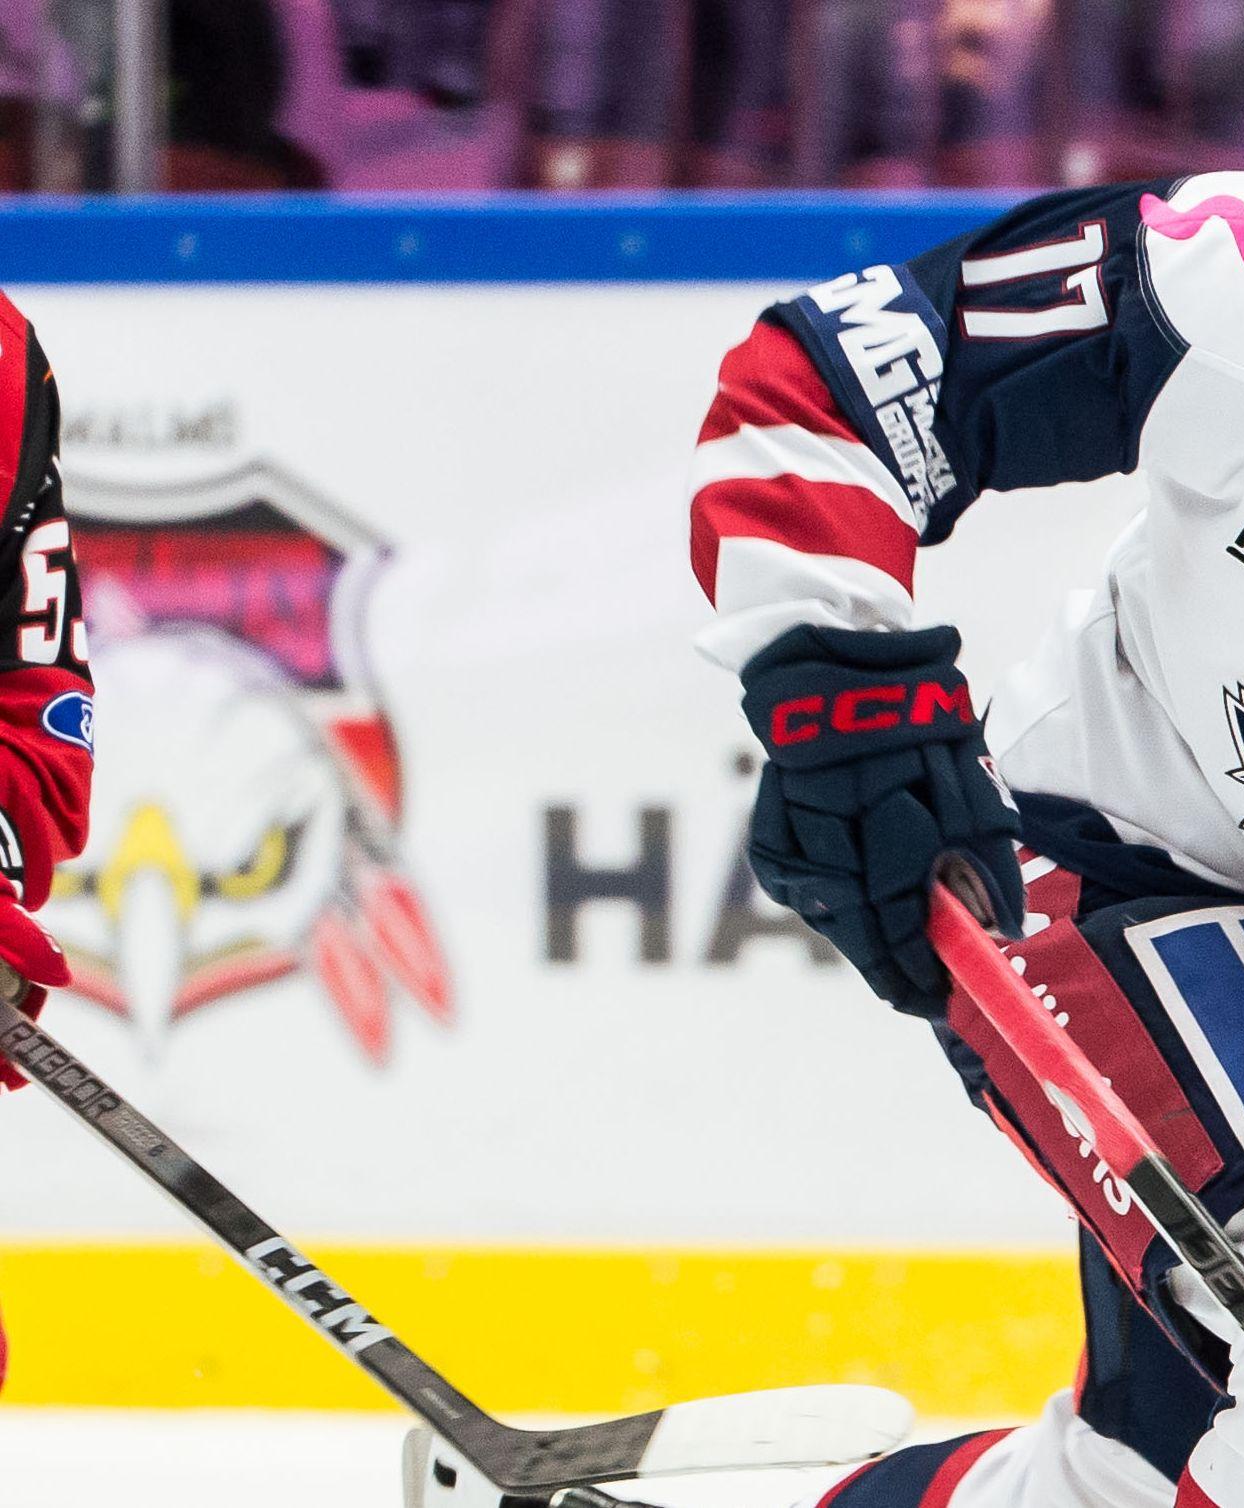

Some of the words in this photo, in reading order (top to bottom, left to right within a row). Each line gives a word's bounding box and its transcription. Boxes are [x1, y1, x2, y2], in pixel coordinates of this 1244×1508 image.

[958, 220, 1111, 340] 17
[770, 680, 975, 747] CCM
[246, 1236, 394, 1355] CCM
